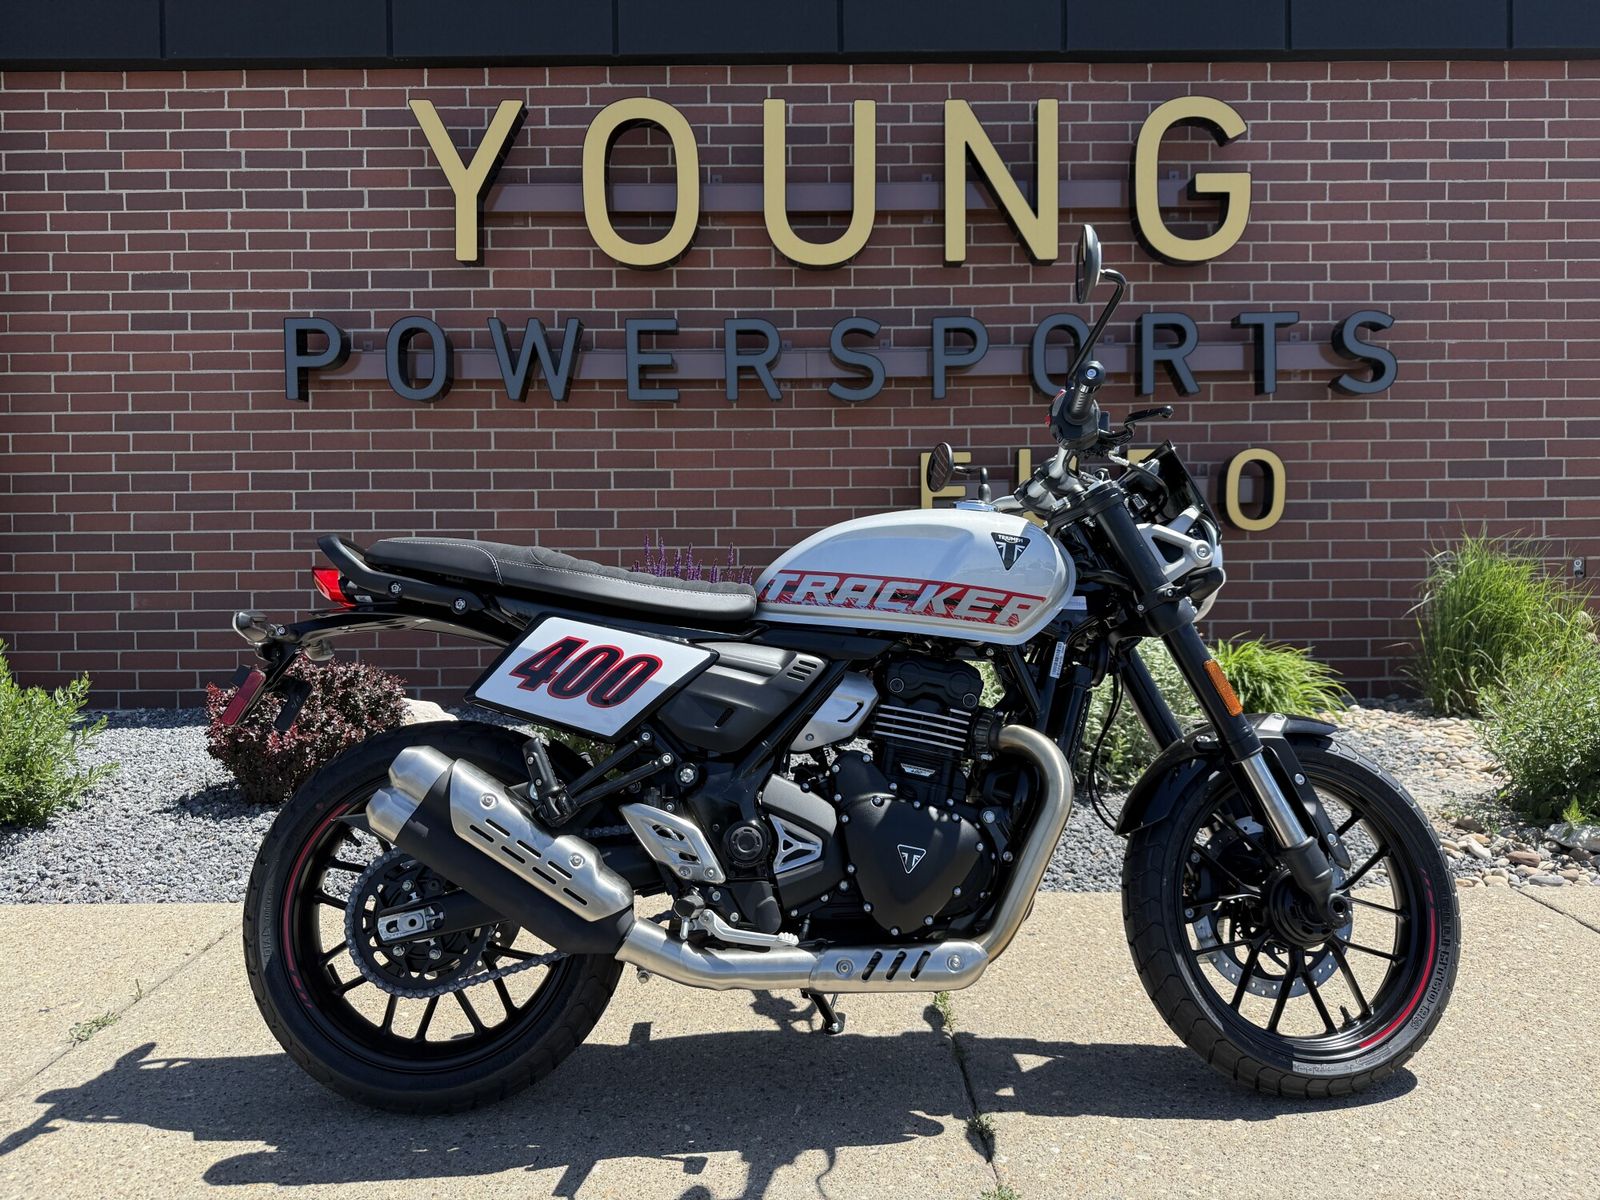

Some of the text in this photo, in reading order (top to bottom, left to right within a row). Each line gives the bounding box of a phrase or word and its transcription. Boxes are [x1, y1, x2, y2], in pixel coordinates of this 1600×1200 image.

[409, 96, 1253, 268] YOUNG
[284, 311, 1398, 402] POWERSPORTS
[764, 572, 1047, 627] TRACKER
[509, 636, 664, 708] 400
